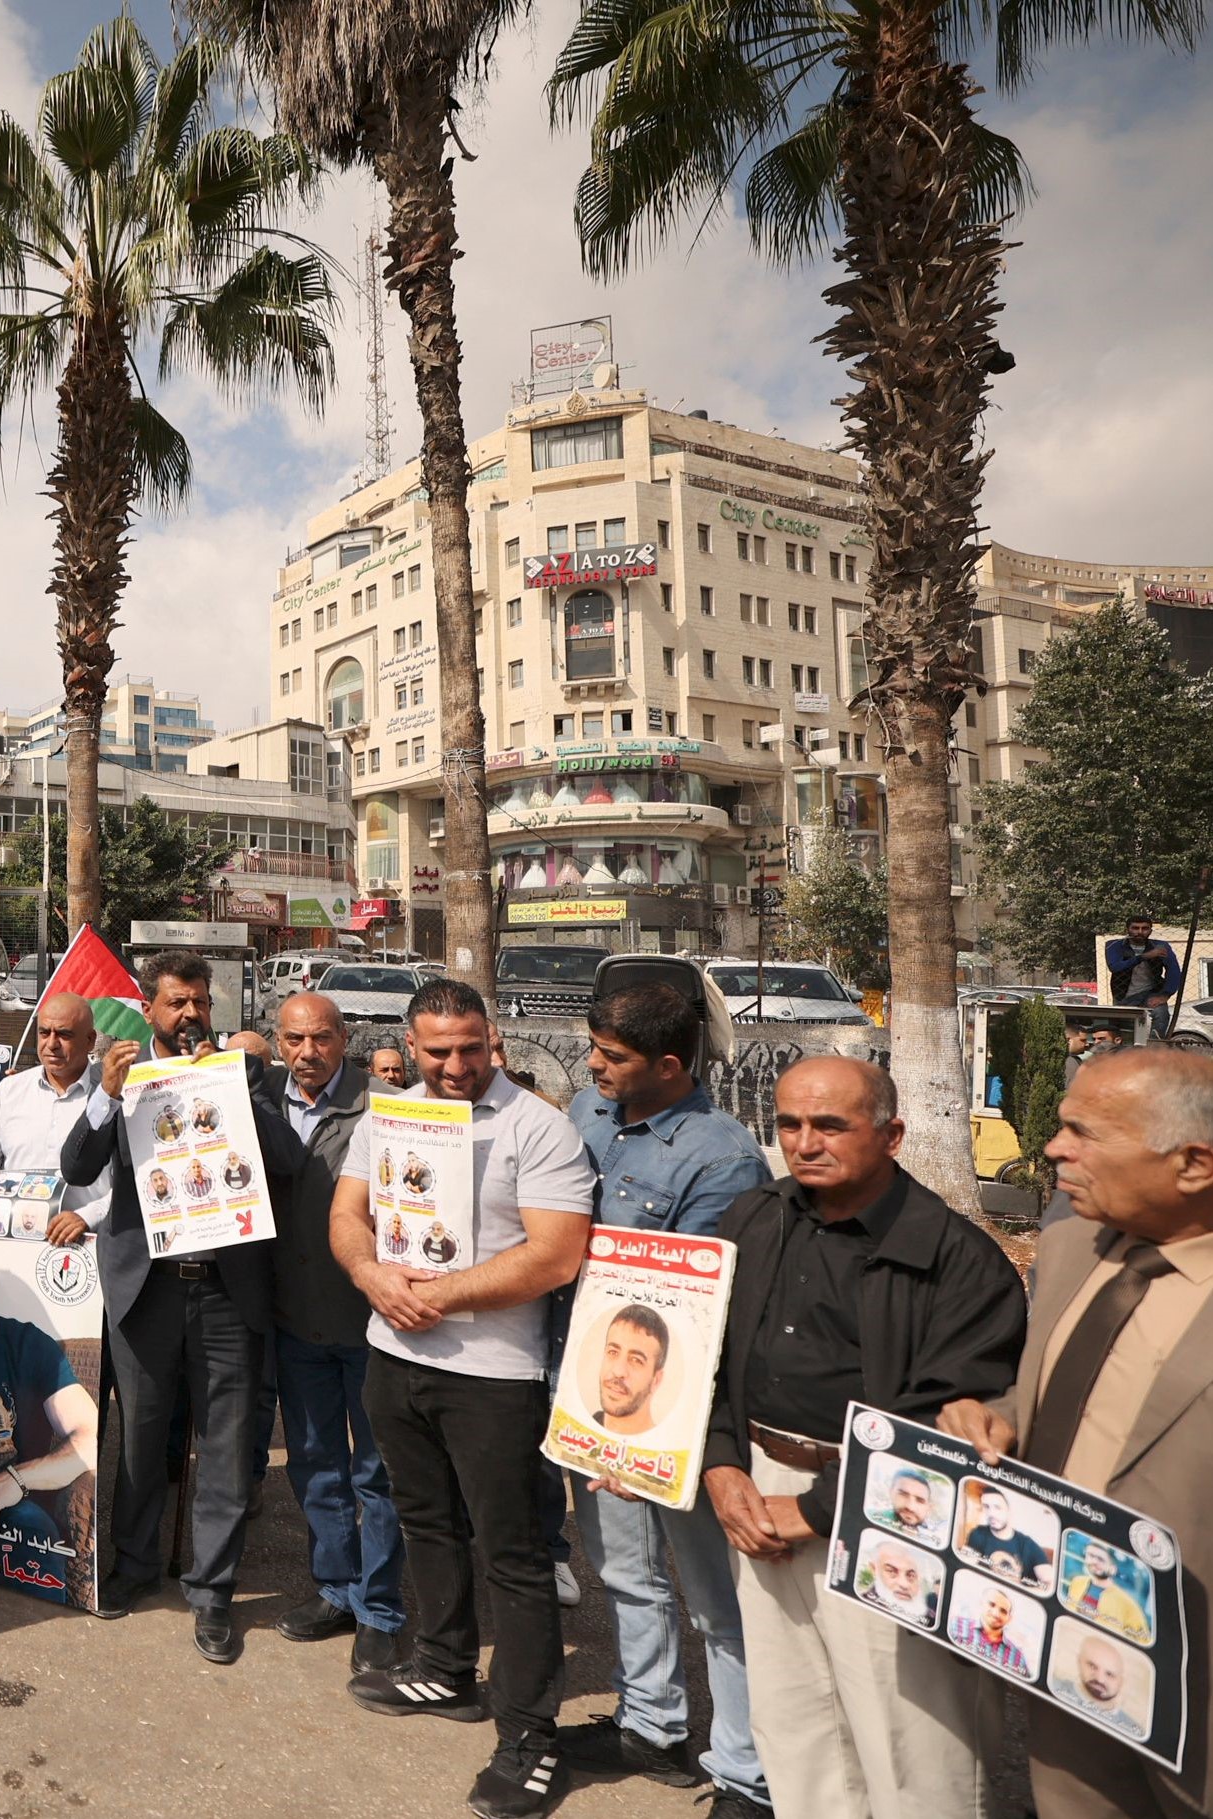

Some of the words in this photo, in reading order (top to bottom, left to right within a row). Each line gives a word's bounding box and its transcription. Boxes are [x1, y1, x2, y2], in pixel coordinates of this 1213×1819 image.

[533, 341, 572, 359] City
[534, 349, 598, 371] Center
[719, 499, 757, 528] City
[762, 508, 821, 539] Center
[581, 553, 593, 570] A
[624, 548, 637, 565] Z
[527, 569, 609, 588] TECHNOLOGY
[615, 564, 656, 579] STORE
[282, 594, 303, 612] City
[305, 576, 343, 602] Center
[557, 755, 654, 772] Hollywood
[178, 929, 195, 938] Map
[523, 993, 589, 1001] DISCOVER
[615, 1239, 648, 1260] العليا
[50, 1292, 66, 1304] Youth
[66, 1283, 92, 1304] Movement
[654, 1292, 682, 1308] الحرية
[557, 1427, 599, 1453] حميد
[599, 1438, 629, 1470] أبو
[629, 1449, 676, 1480] ناصر
[916, 1440, 969, 1467] فلسطين
[976, 1460, 1031, 1490] الفتحاوية
[1030, 1482, 1074, 1508] الشبيبة
[1073, 1500, 1107, 1524] حركة
[27, 1536, 77, 1558] كايد
[2, 1544, 66, 1590] حتماً
